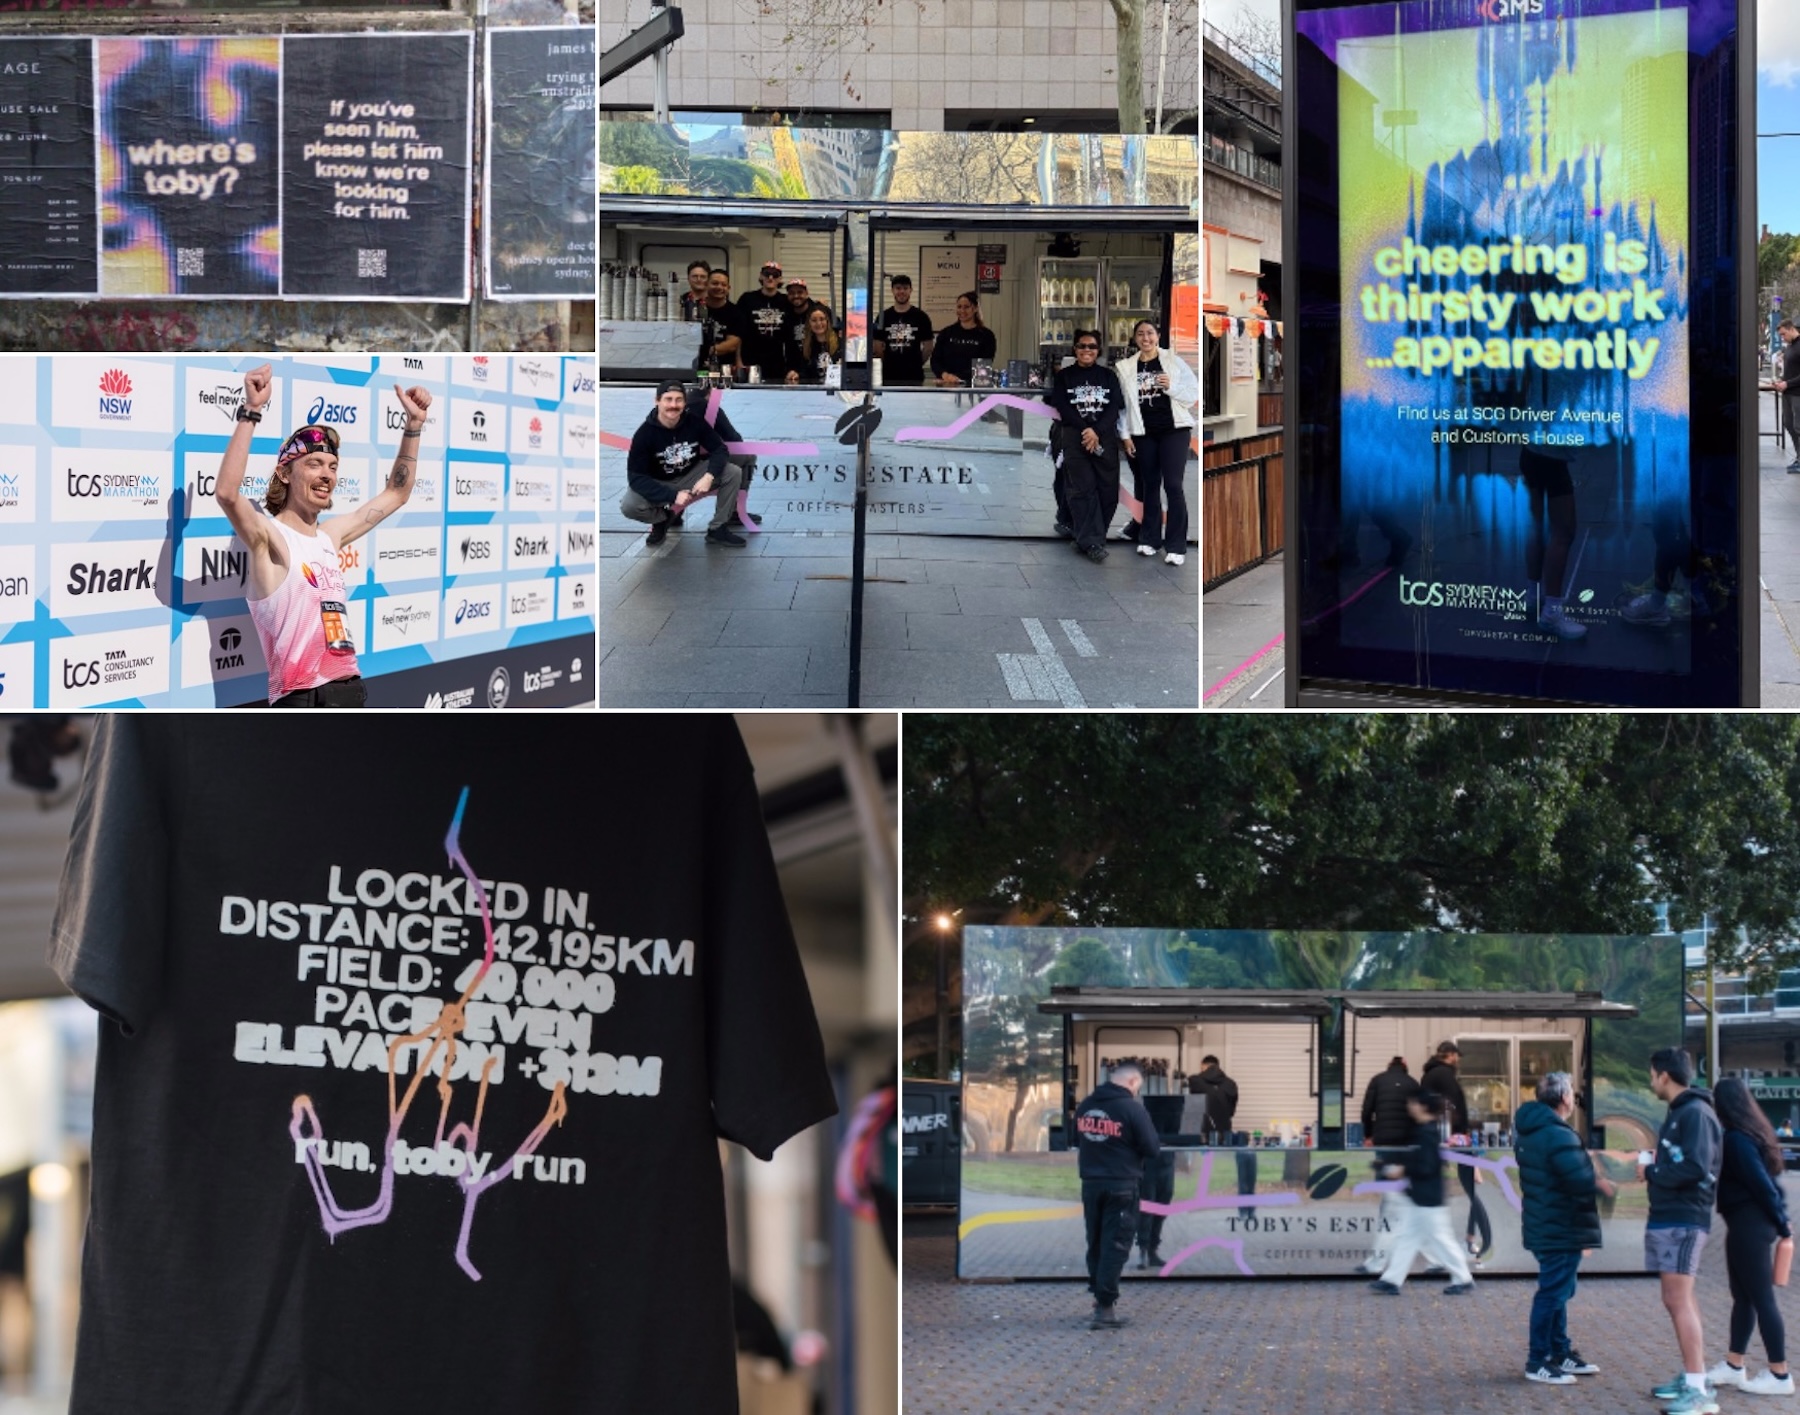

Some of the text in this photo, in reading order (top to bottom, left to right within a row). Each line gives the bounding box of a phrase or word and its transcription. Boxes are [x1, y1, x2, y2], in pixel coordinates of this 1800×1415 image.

[547, 43, 586, 57] james
[3, 62, 42, 74] AGE
[546, 71, 586, 84] trying
[0, 105, 59, 114] USE SALE
[348, 101, 416, 120] you've
[323, 123, 371, 138] seen
[127, 137, 257, 165] where's
[303, 140, 444, 161] please let him
[315, 160, 430, 181] know we're
[143, 166, 240, 201] toby?
[334, 181, 409, 204] looking
[334, 201, 411, 220] for him.
[546, 256, 576, 266] opera
[1375, 231, 1649, 284] cheering is
[1360, 279, 1666, 331] thirsty work
[403, 358, 424, 370] TATA
[99, 397, 132, 414] NSW
[199, 390, 239, 405] feel new
[99, 413, 132, 421] GOVERNMENT
[1397, 406, 1622, 423] Find us at SCG Driver Avenue
[470, 431, 487, 442] TATA
[1430, 429, 1585, 446] and Customs House
[103, 474, 141, 487] SYDNEY
[748, 464, 848, 483] TOBY'S
[68, 468, 102, 497] tcs
[197, 470, 216, 497] tc
[456, 476, 472, 495] tcs
[103, 486, 160, 497] MARATHON
[787, 501, 925, 514] COFFEE RASTERS
[469, 541, 491, 560] SBS
[568, 530, 595, 557] NINJA
[379, 547, 438, 560] PORSCHE
[201, 547, 249, 588] NINJ
[1400, 574, 1444, 607] tcs
[1446, 584, 1499, 600] SYDNEY
[1446, 597, 1527, 612] MARATHON
[382, 610, 432, 625] feel new sydney
[105, 650, 127, 661] TATA
[105, 656, 155, 672] CONSULTANCY
[215, 654, 245, 670] TATA
[64, 658, 101, 689] tcs
[104, 670, 137, 683] SERVICES
[523, 671, 541, 693] tcs
[328, 866, 597, 931] LOCKED IN.
[219, 896, 695, 977] DISTANCE: 42.195KM
[297, 944, 616, 1014] FIELD: 40,000
[463, 1003, 593, 1051] EVEN
[295, 1137, 377, 1174] run,
[513, 1154, 587, 1184] run
[1226, 1216, 1392, 1233] TOBY'S ESTA
[1266, 1250, 1313, 1259] COFFEE
